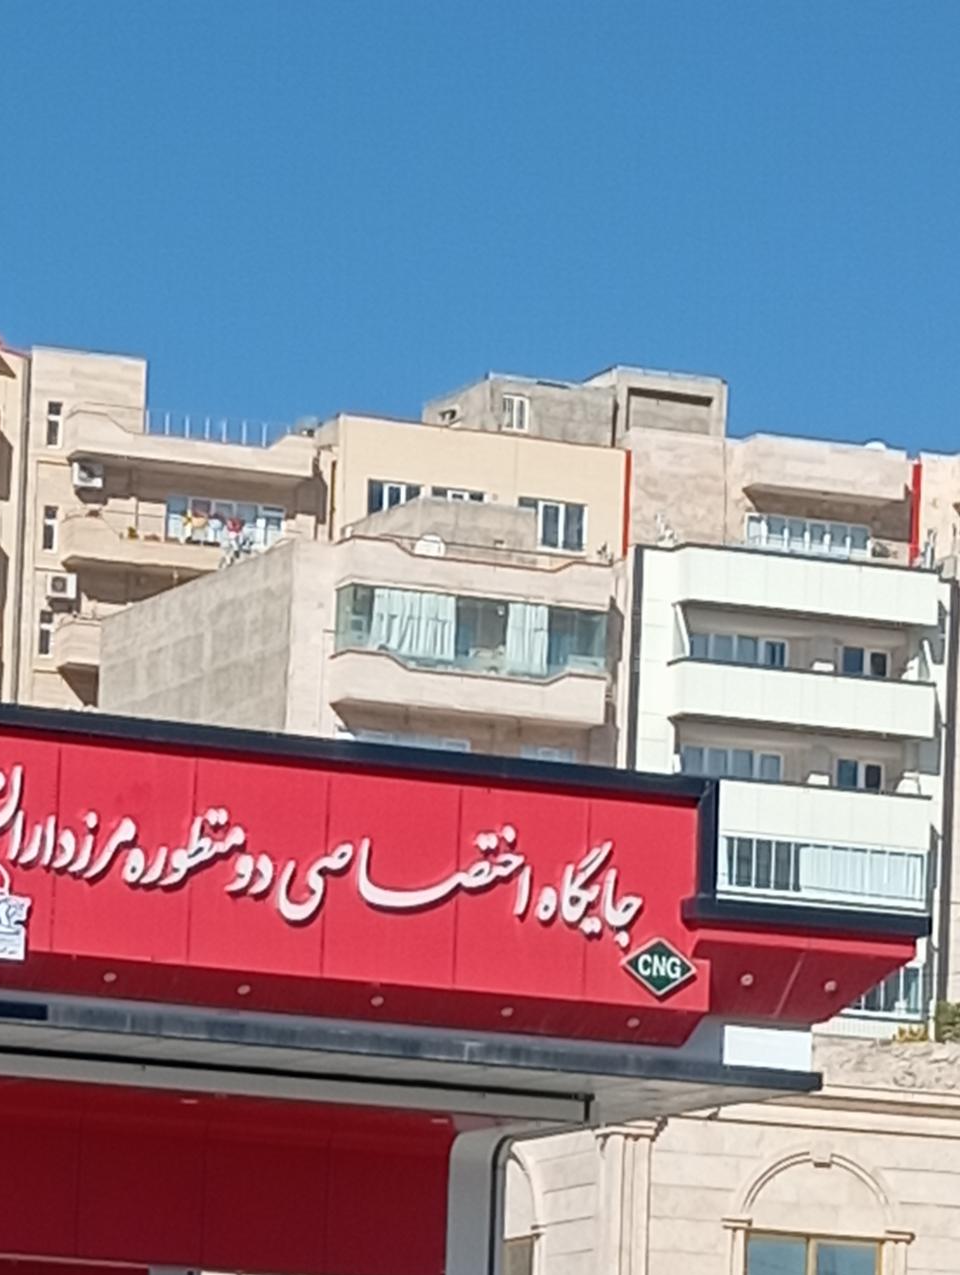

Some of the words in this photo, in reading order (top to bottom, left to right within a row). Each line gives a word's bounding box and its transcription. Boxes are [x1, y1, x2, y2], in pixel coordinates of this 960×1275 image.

[276, 825, 531, 921] اختصاصی
[533, 840, 643, 948] جایگاه
[637, 954, 682, 979] CNG
